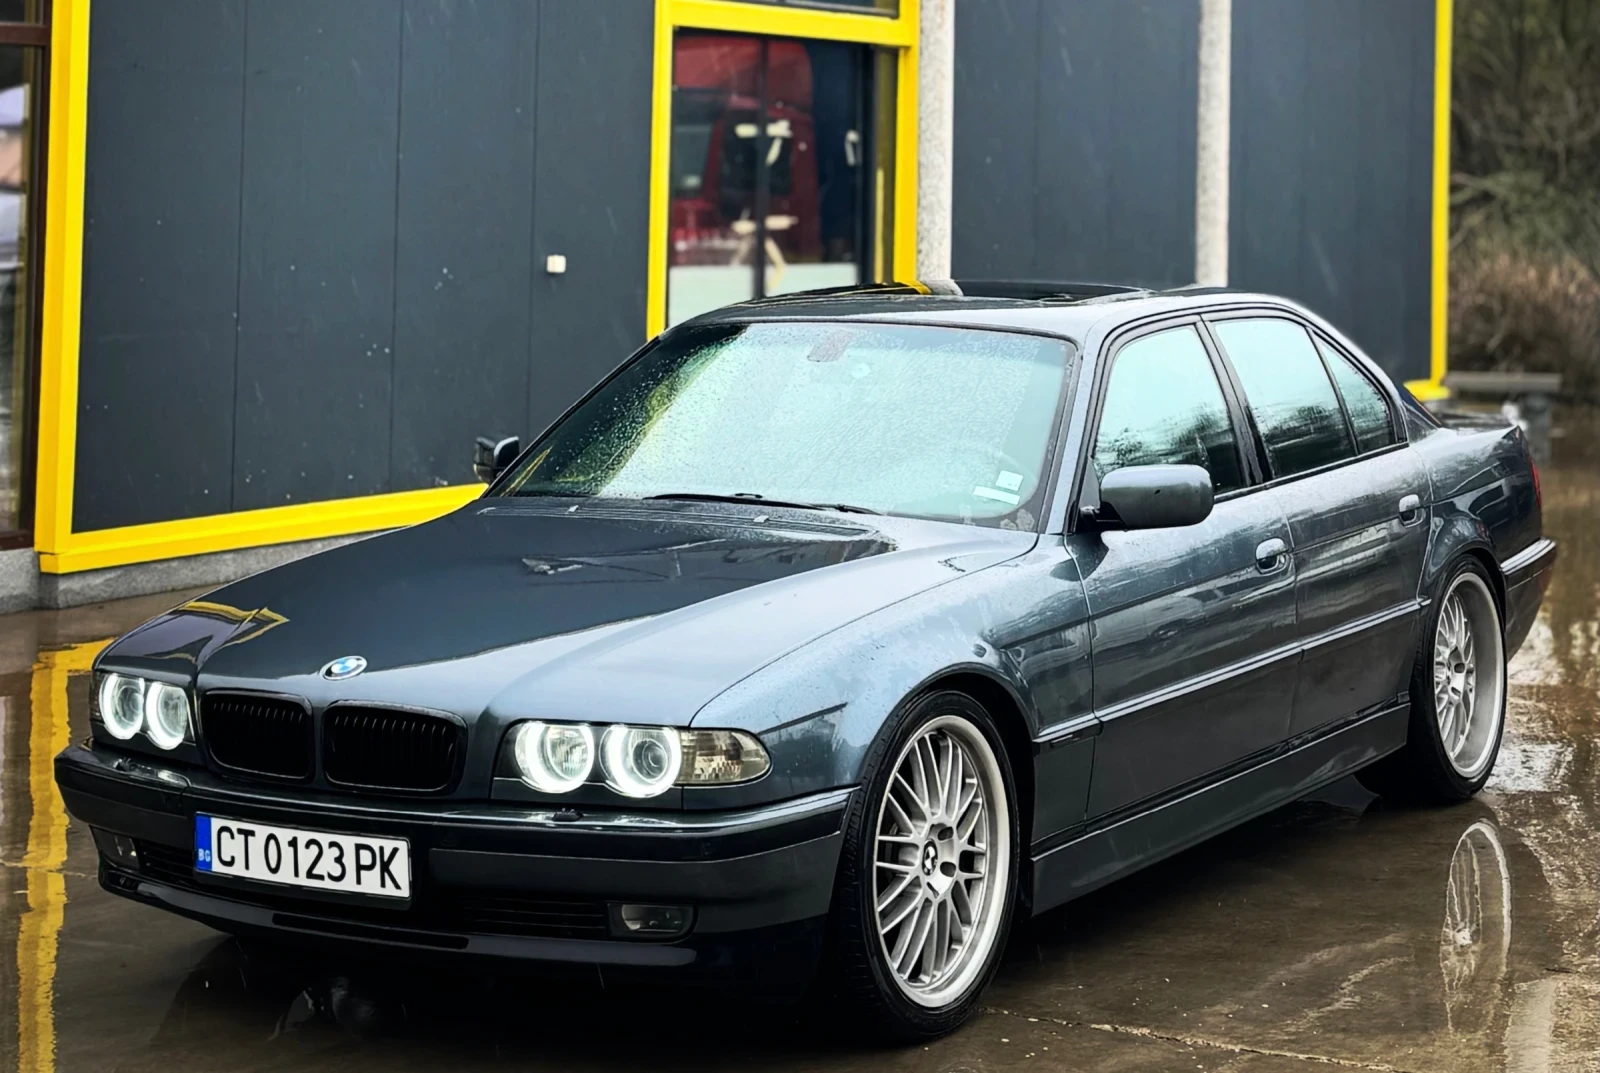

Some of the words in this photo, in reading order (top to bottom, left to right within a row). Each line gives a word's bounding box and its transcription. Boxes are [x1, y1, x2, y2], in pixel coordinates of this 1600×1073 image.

[198, 848, 211, 862] BG
[216, 825, 256, 870] CT
[263, 832, 347, 883] 0123
[354, 842, 402, 890] PK
